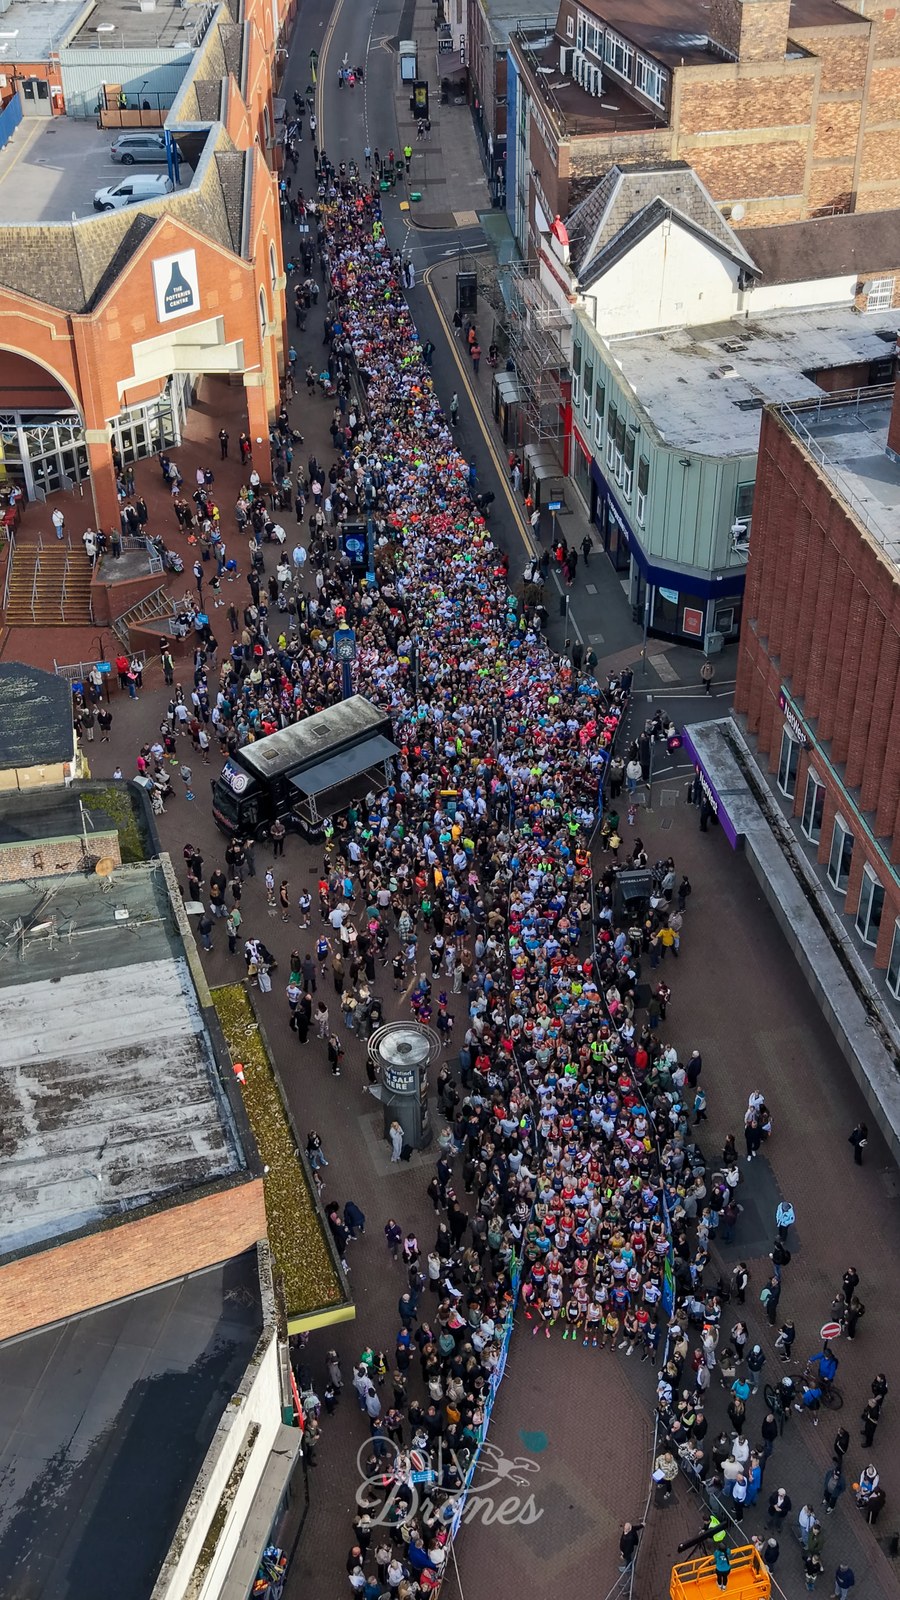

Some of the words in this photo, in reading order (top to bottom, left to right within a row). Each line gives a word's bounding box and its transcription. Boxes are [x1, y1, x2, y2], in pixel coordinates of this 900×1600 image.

[166, 290, 191, 301] POTTERIES
[170, 298, 189, 307] CENTRE
[386, 1078, 408, 1090] HERE
[392, 1075, 414, 1084] SALE
